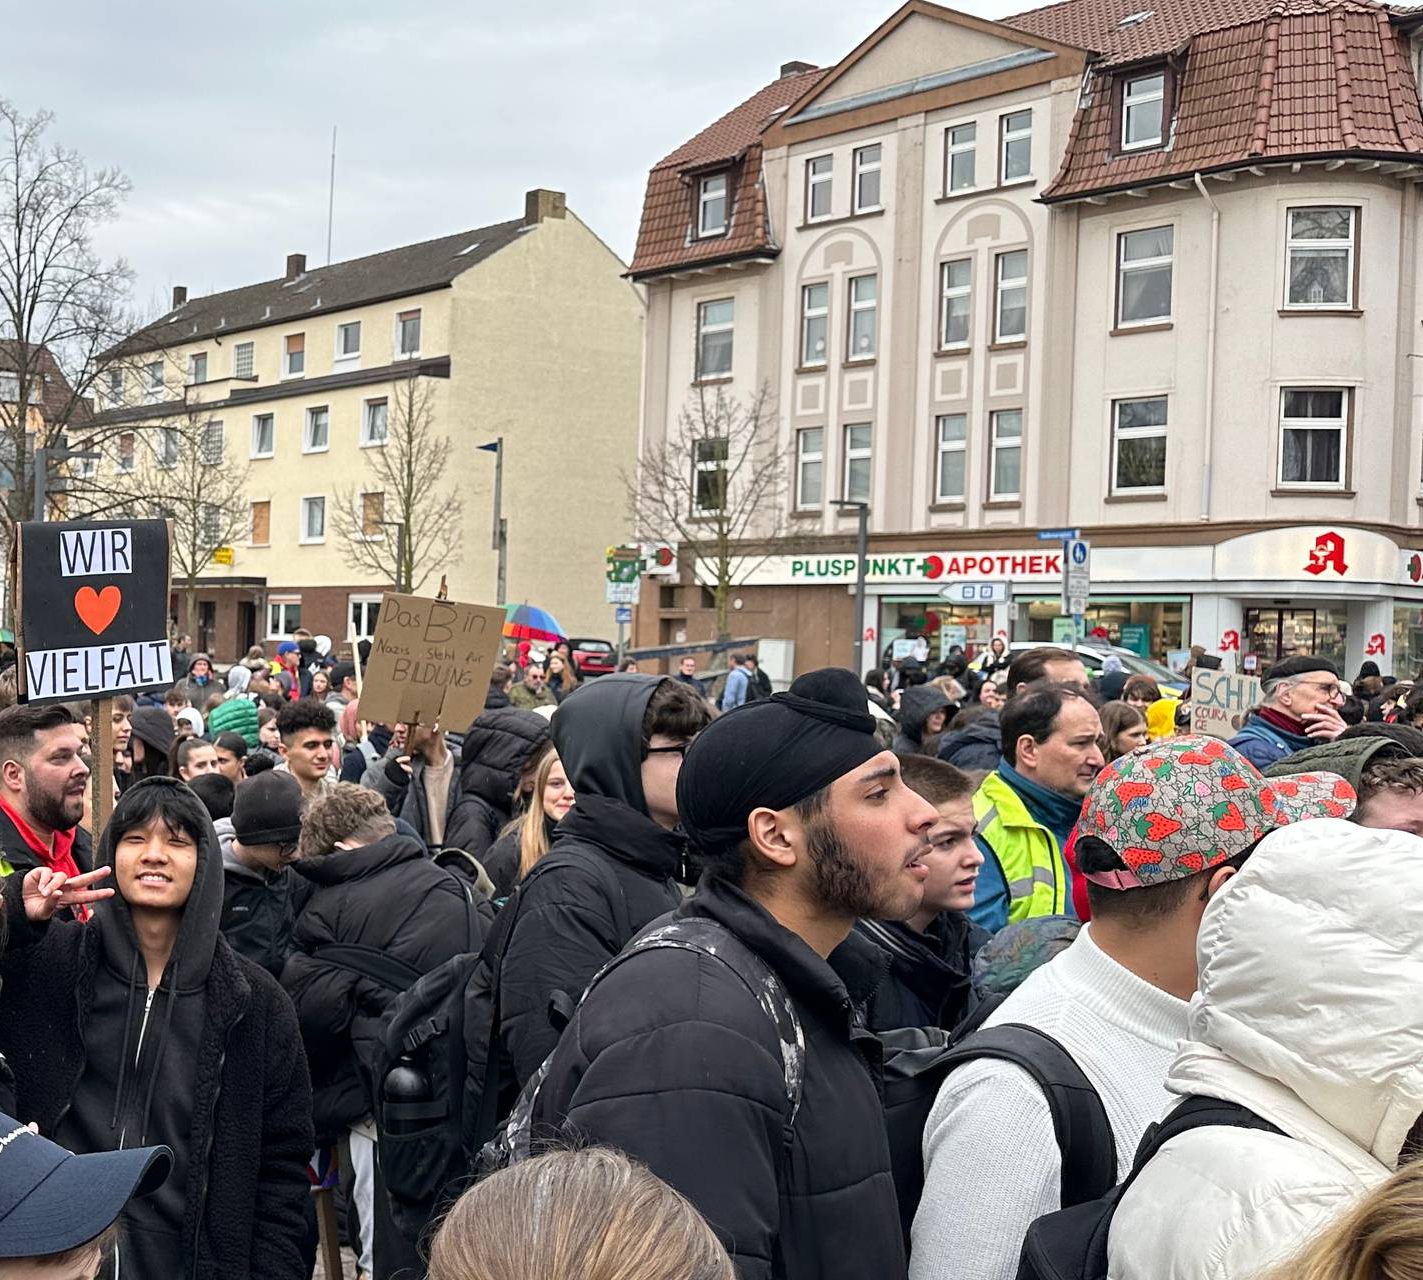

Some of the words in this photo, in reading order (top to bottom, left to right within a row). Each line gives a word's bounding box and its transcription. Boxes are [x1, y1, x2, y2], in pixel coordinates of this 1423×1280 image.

[61, 530, 130, 574] WIR
[383, 599, 421, 628] Das
[423, 604, 458, 643] B
[462, 612, 487, 634] in
[376, 637, 410, 656] Nazis
[27, 642, 167, 696] VIELFALT
[392, 658, 473, 688] BILDUNG
[1194, 705, 1228, 722] COURA
[1194, 719, 1208, 731] GE
